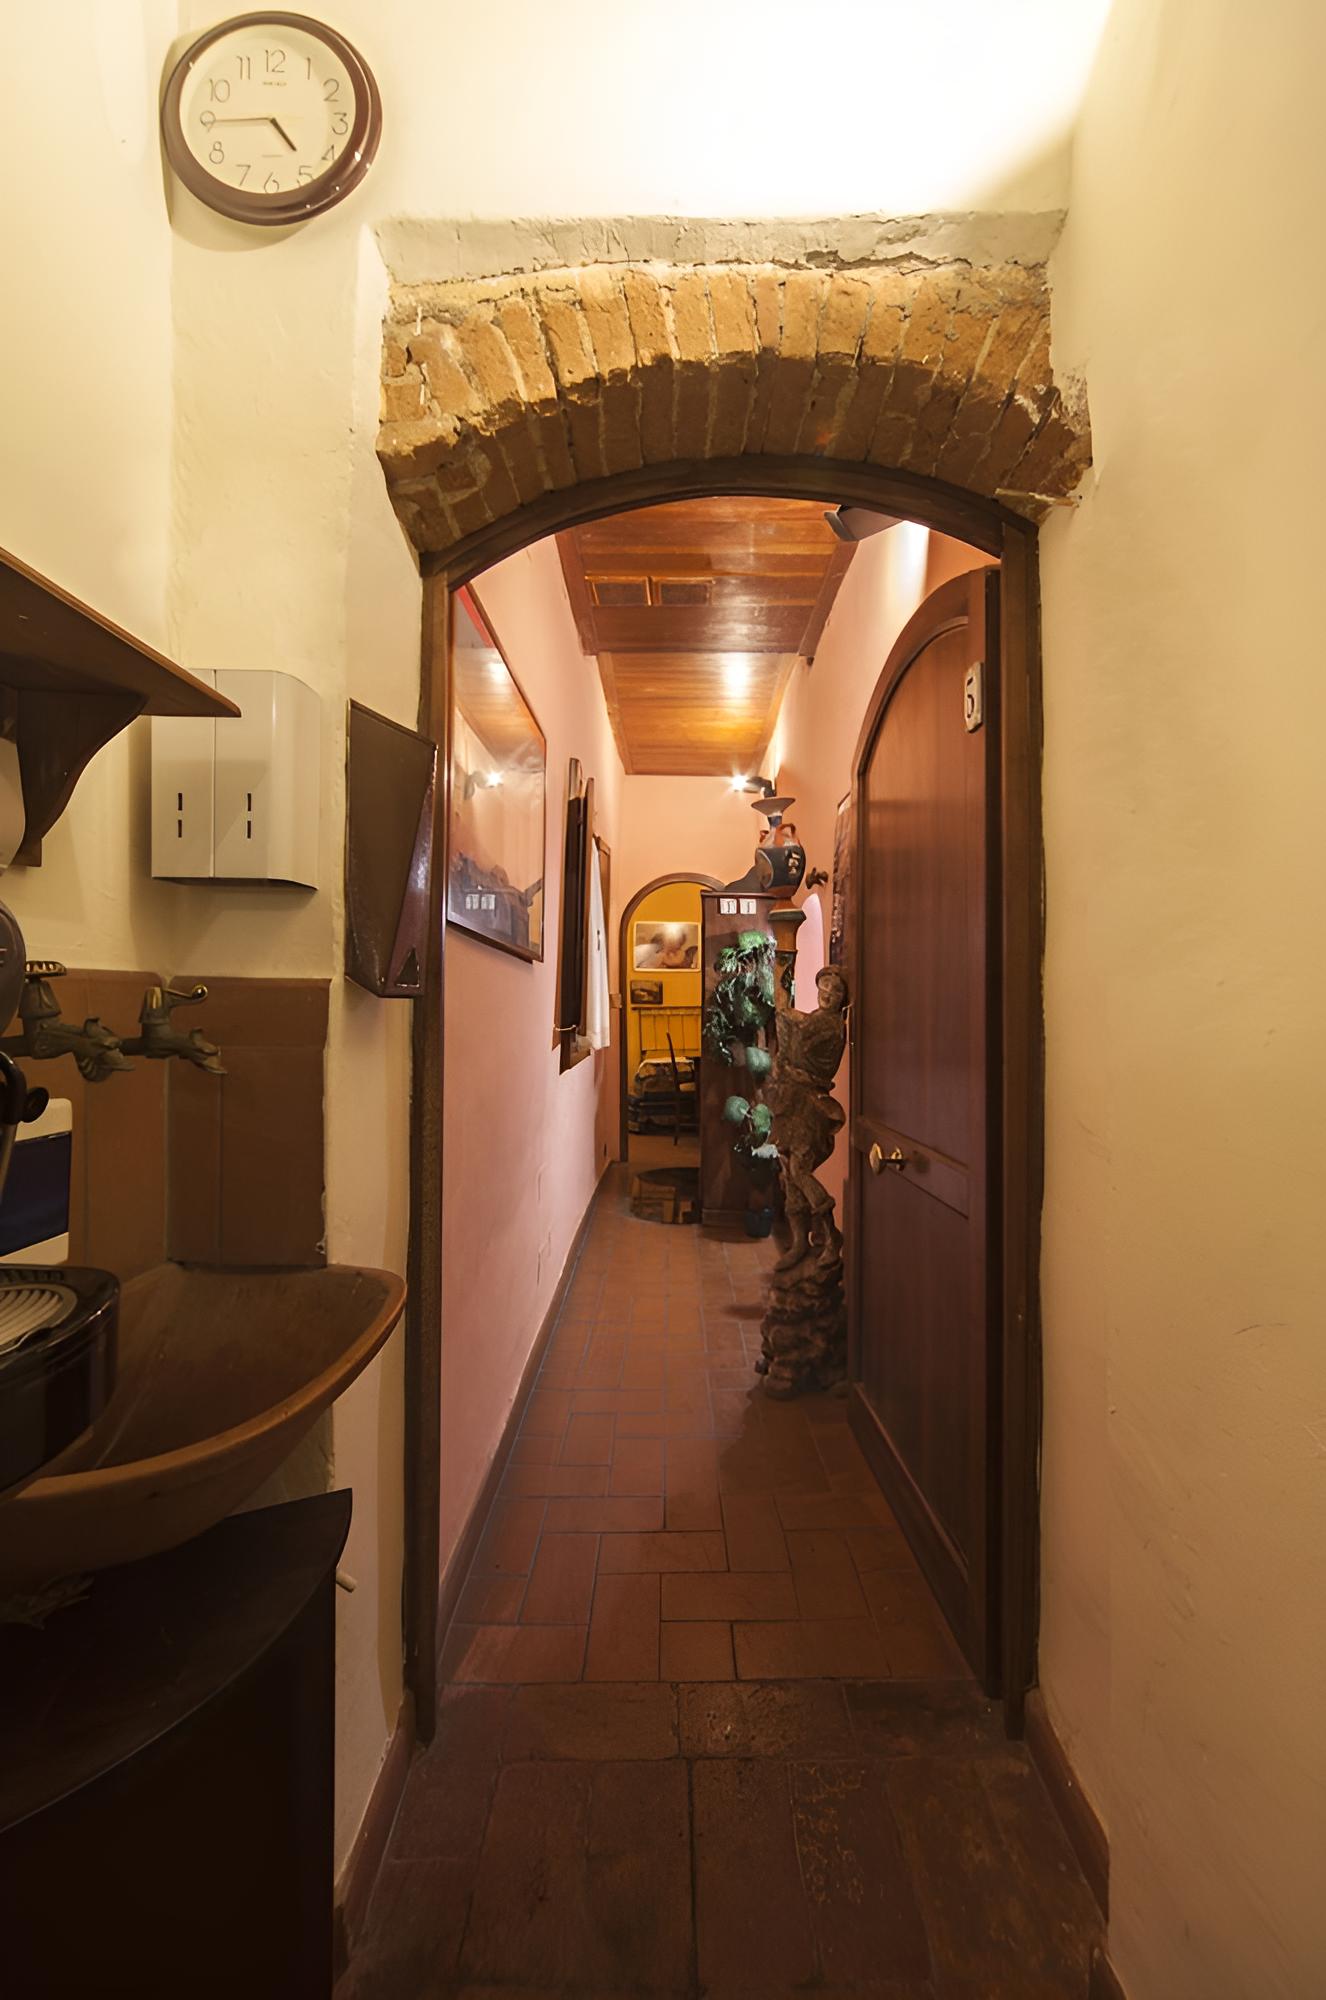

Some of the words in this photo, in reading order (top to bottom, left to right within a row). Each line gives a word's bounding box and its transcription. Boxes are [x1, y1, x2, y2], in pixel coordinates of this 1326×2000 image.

[236, 55, 251, 80] 11
[264, 49, 286, 73] 12
[305, 56, 312, 80] 1
[208, 77, 231, 103] 10
[322, 78, 340, 102] 2
[200, 110, 217, 132] 9
[331, 112, 349, 135] 3
[208, 140, 225, 164] 8
[320, 144, 335, 161] 4
[235, 164, 251, 186] 7
[263, 171, 280, 194] 6
[296, 165, 314, 187] 5
[965, 676, 975, 719] 5
